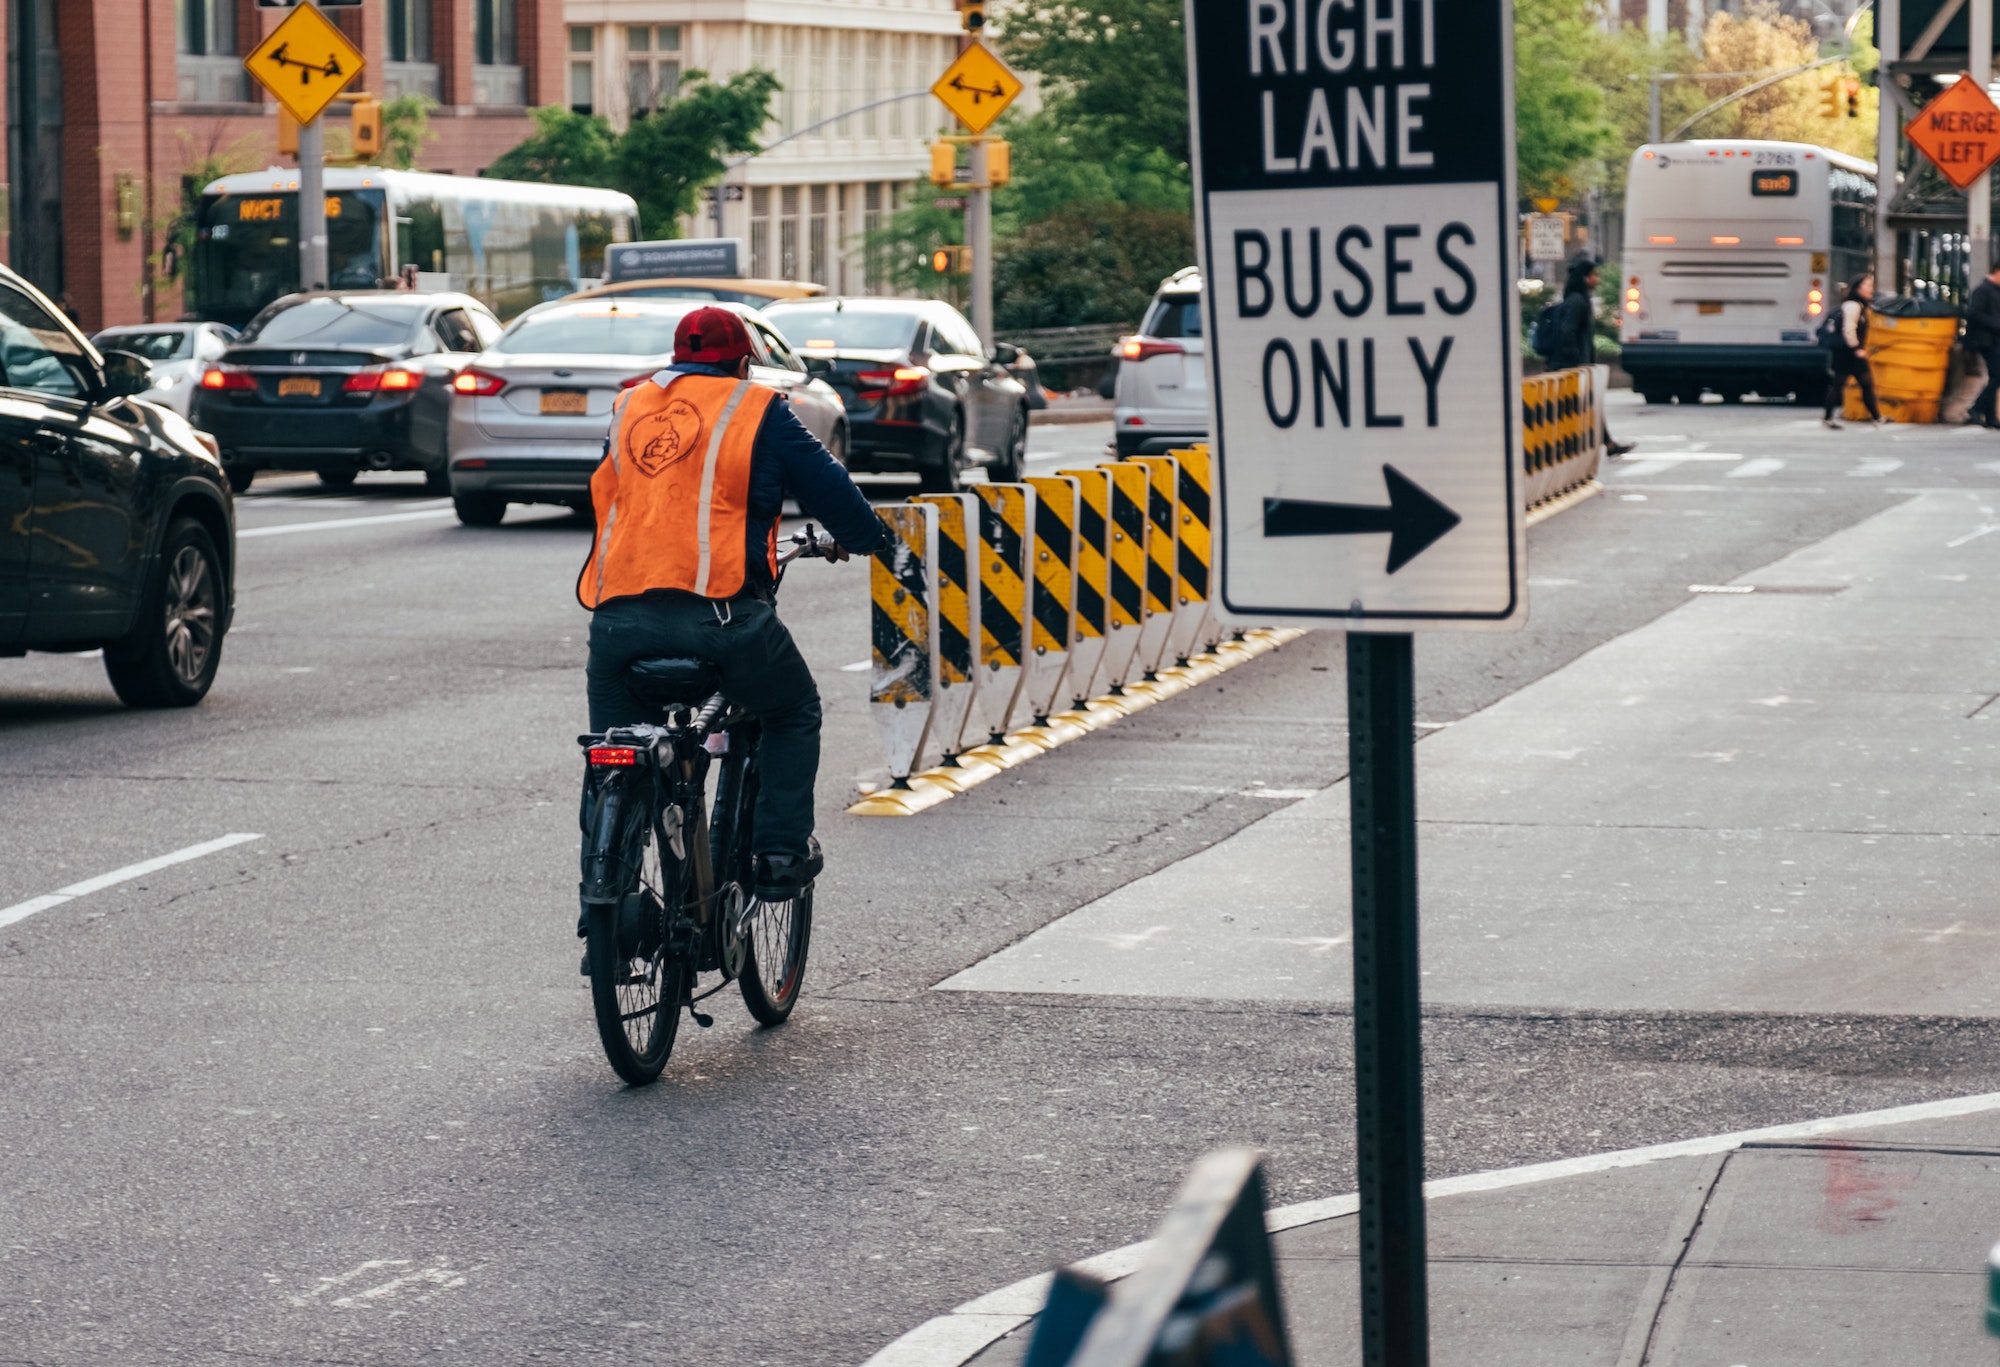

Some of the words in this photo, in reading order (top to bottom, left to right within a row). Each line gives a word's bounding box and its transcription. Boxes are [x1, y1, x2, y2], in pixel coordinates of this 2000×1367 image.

[1262, 83, 1435, 173] LANE
[1930, 111, 1998, 134] MERGE
[1938, 141, 1988, 163] LEFT
[1234, 222, 1477, 319] BUSES
[1262, 335, 1455, 429] ONLY
